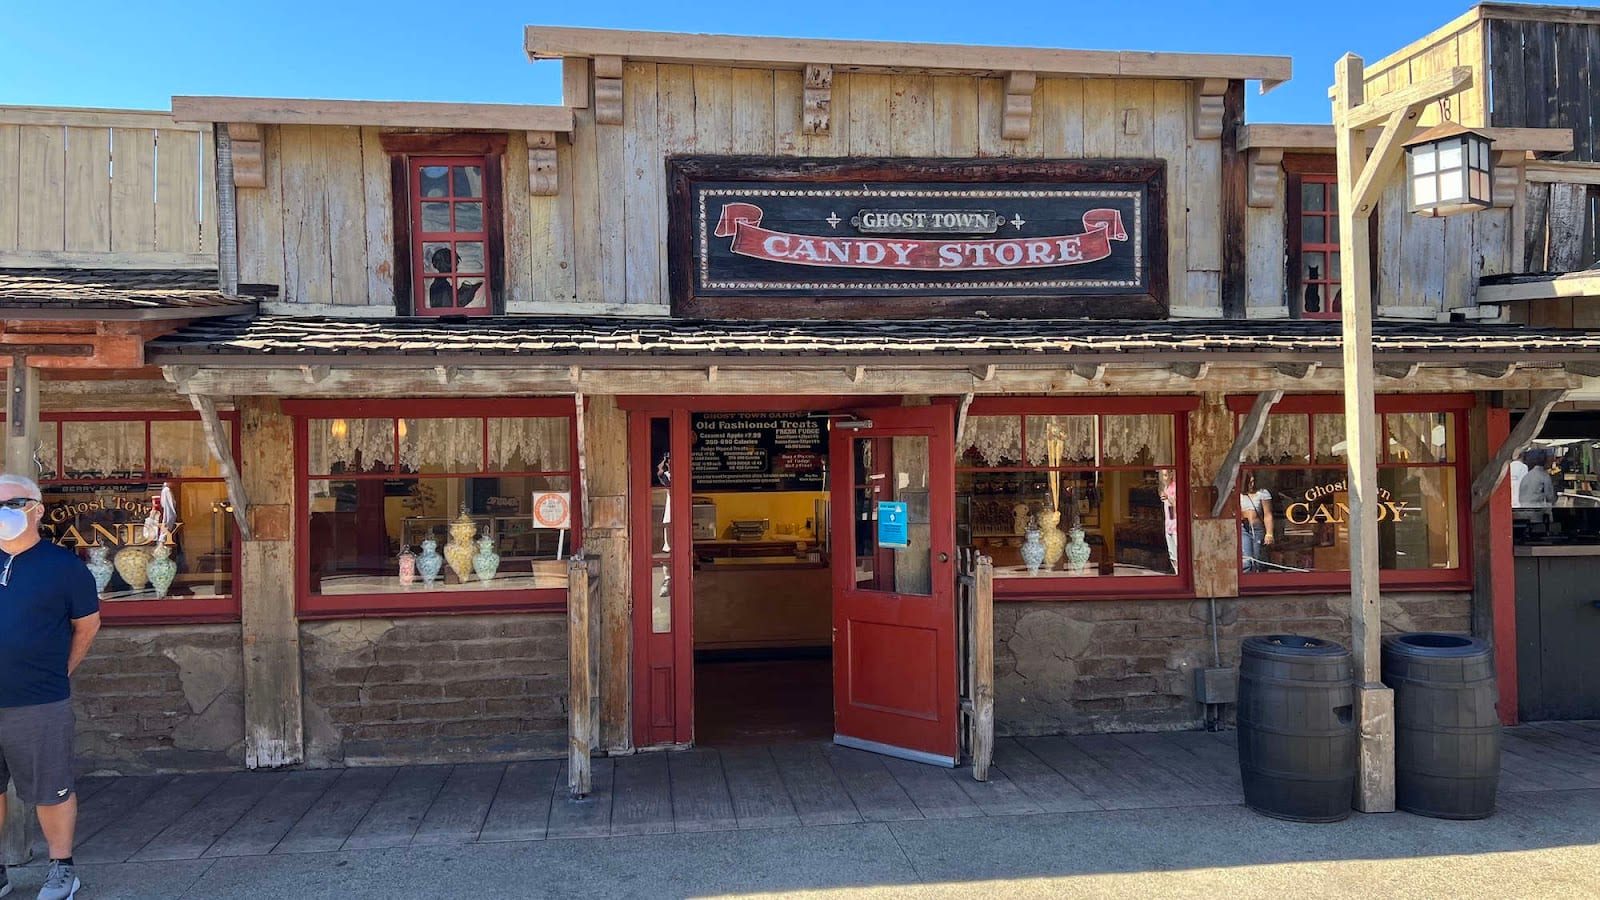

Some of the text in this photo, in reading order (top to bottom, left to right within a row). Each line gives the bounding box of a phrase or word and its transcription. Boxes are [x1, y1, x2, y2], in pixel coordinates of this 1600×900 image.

[862, 212, 990, 228] GHOST TOWN
[763, 235, 1083, 267] CANDY STORE
[696, 420, 819, 430] Old Fashioned Treats
[1304, 479, 1349, 502] Ghost
[50, 497, 105, 522] Ghost
